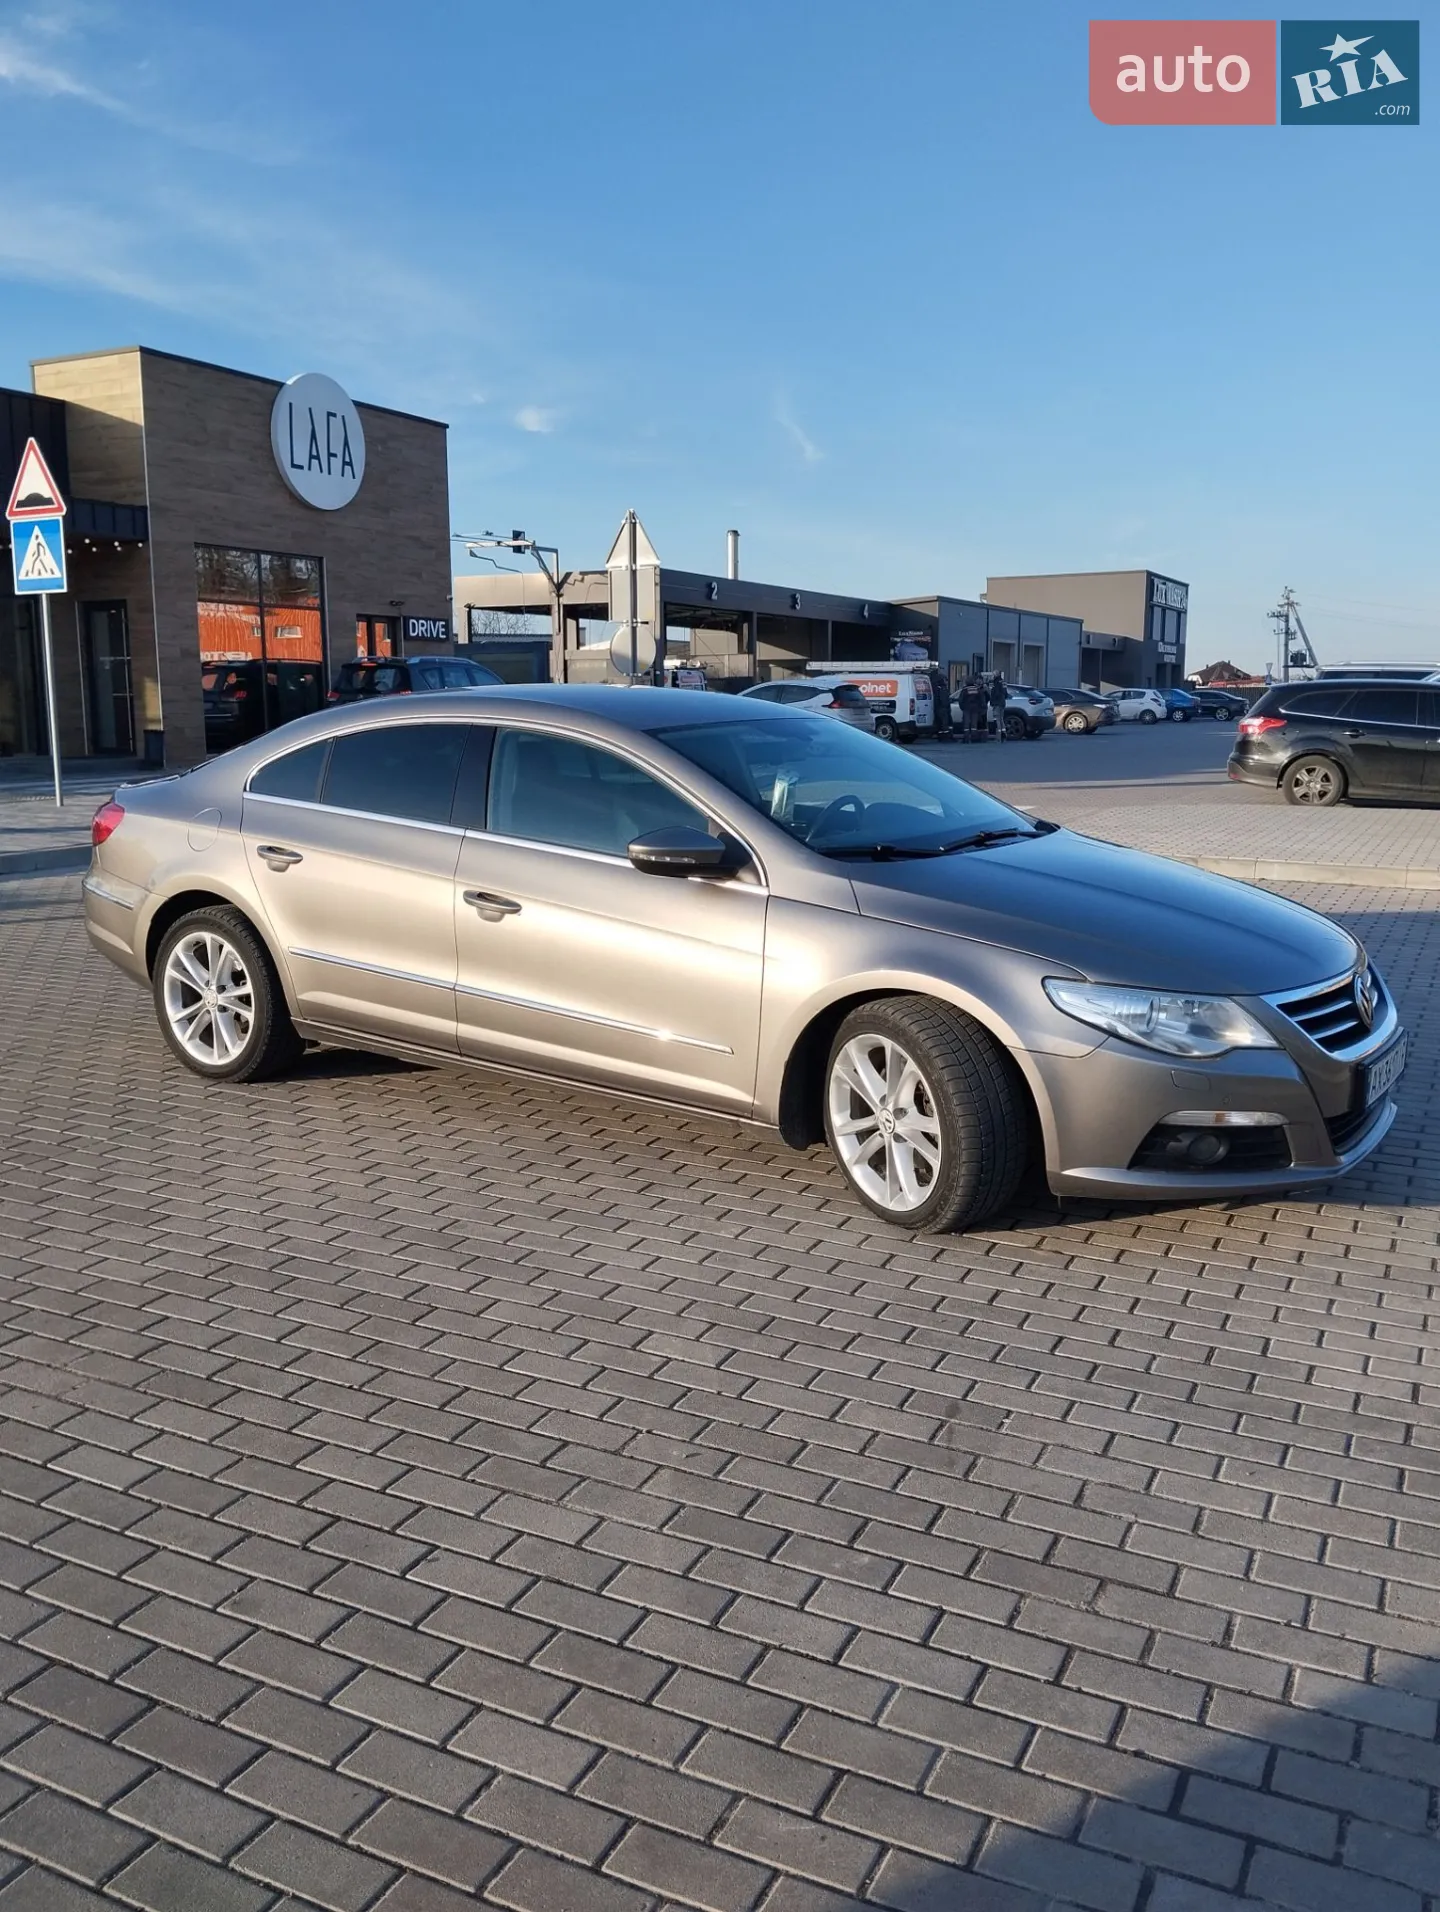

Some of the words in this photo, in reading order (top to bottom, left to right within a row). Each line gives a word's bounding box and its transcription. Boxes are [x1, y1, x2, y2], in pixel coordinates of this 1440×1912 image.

[289, 402, 356, 480] LAFA
[711, 581, 718, 600] 2
[795, 593, 801, 610] 3
[863, 604, 869, 619] 4
[409, 618, 447, 639] DRIVE
